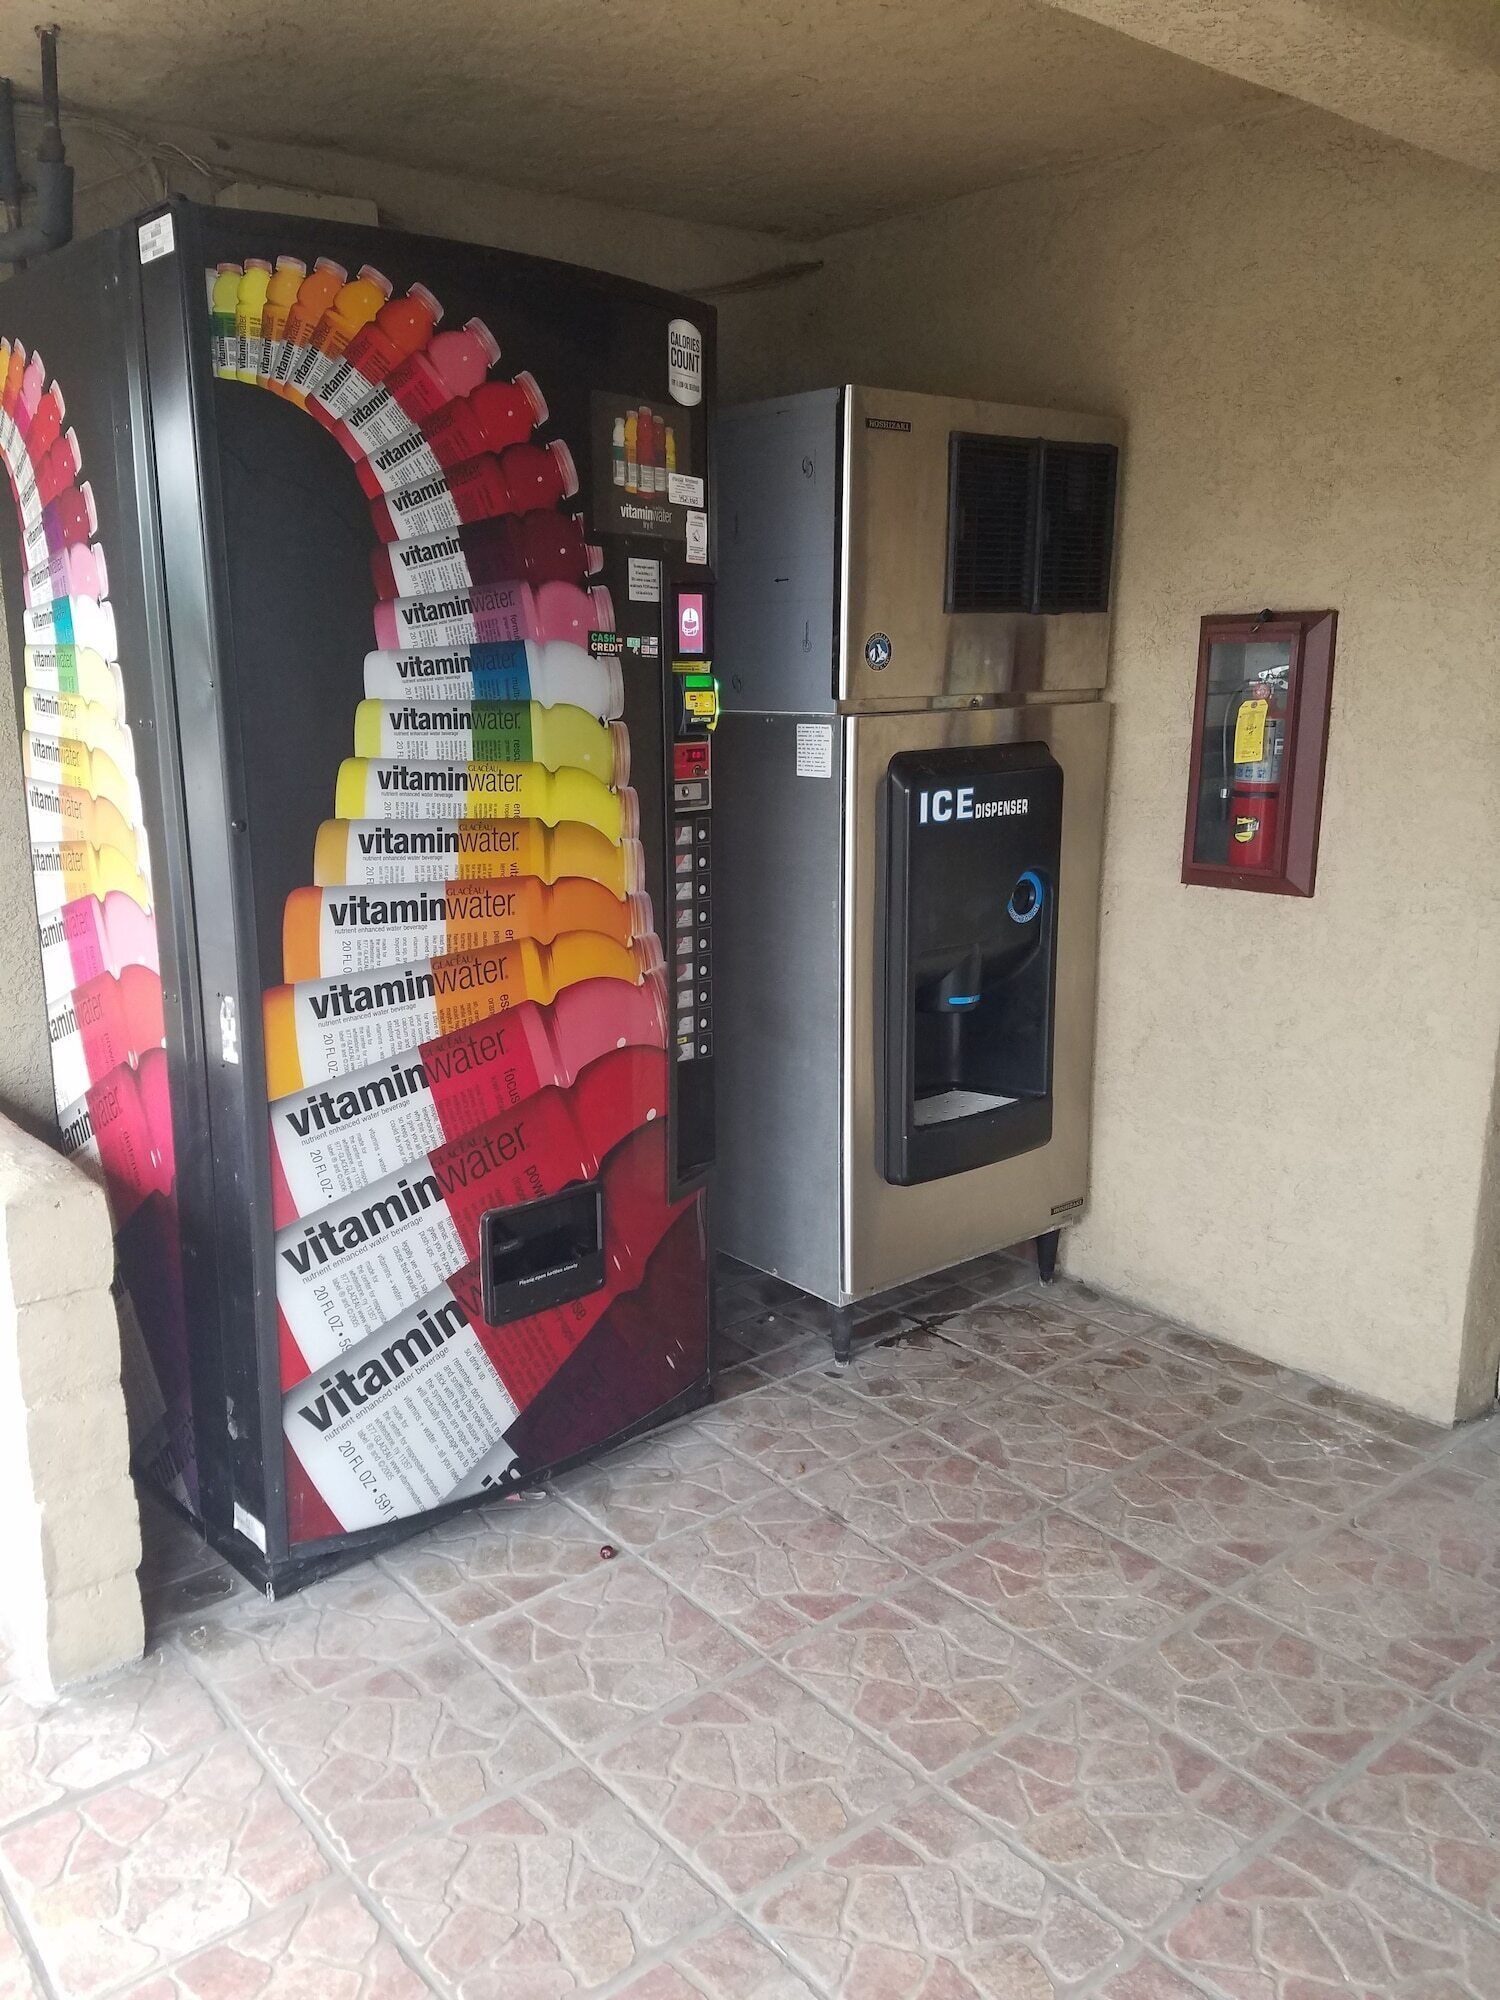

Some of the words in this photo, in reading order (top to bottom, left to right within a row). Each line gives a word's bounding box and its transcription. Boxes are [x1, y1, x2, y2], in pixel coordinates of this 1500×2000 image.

[671, 331, 700, 353] CALORIES
[671, 347, 700, 373] COUNT
[591, 633, 615, 643] CASH
[591, 643, 624, 652] CREDIT
[920, 787, 974, 824] ICE
[975, 799, 1029, 819] DISPENSER
[341, 940, 351, 951] 20
[342, 954, 352, 964] FL
[323, 1033, 334, 1045] 20
[325, 1047, 336, 1058] FL
[327, 1059, 338, 1073] OZ
[504, 1068, 520, 1105] focus
[300, 1130, 327, 1146] nutrient
[327, 1117, 360, 1136] enhanced
[361, 1110, 380, 1122] water
[380, 1097, 410, 1115] beverage
[309, 1149, 323, 1163] 20
[314, 1163, 328, 1177] FL
[319, 1177, 333, 1192] OZ
[301, 1263, 333, 1284] nutrient
[331, 1244, 368, 1268] enhanced
[368, 1233, 390, 1248] water
[389, 1214, 424, 1237] beverage
[312, 1285, 329, 1301] 20
[320, 1300, 336, 1316] FL
[326, 1314, 344, 1331] OZ
[443, 1363, 455, 1376] and
[467, 1355, 481, 1371] drink
[425, 1377, 436, 1389] the
[433, 1371, 447, 1387] stick
[442, 1385, 455, 1400] with
[450, 1398, 461, 1410] the
[322, 1416, 355, 1442] nutrient
[354, 1388, 393, 1419] enhanced
[392, 1372, 415, 1391] water
[414, 1346, 450, 1375] beverage
[337, 1439, 356, 1458] 20
[347, 1454, 366, 1473] FL
[357, 1469, 377, 1489] OZ
[373, 1492, 394, 1515] 591
